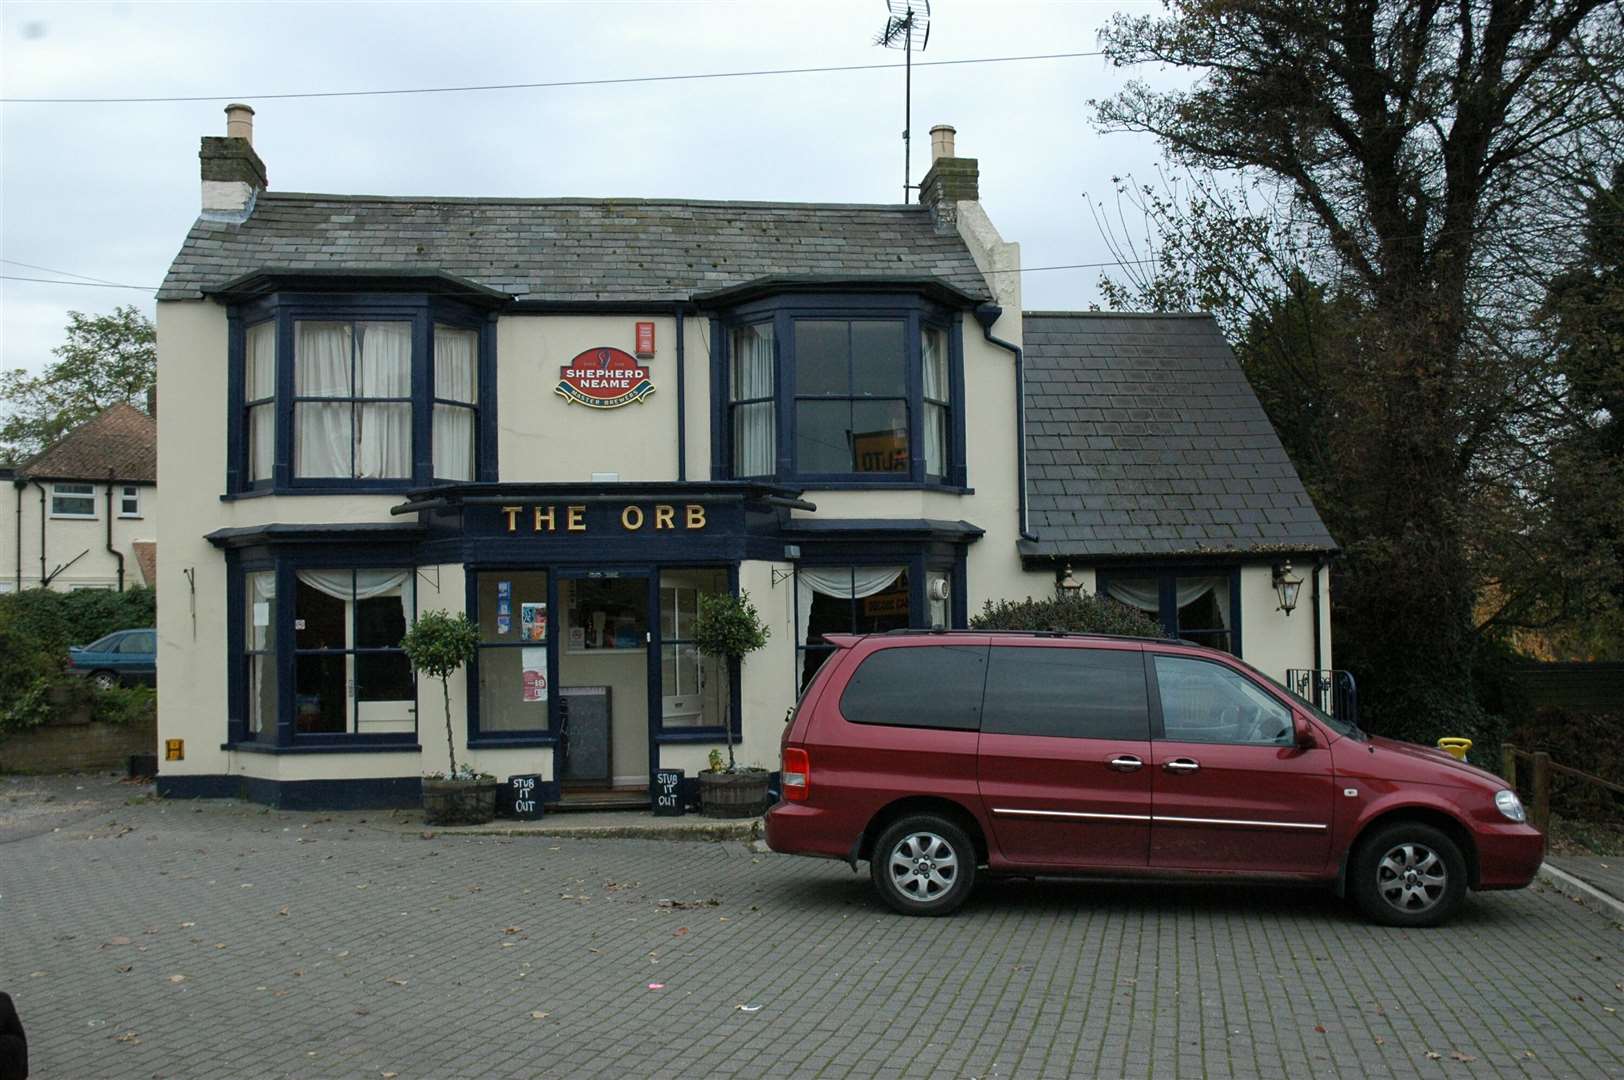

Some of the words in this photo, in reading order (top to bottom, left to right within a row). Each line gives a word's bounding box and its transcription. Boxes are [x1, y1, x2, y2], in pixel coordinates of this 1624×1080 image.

[566, 369, 644, 378] SHEPHERD
[580, 379, 630, 388] NEAME
[571, 389, 601, 405] MASTER
[604, 391, 639, 406] BREWERS
[502, 505, 587, 531] THE
[621, 504, 707, 530] ORB
[513, 778, 535, 789] STUB
[657, 773, 678, 785] STUB
[519, 787, 531, 799] IT
[664, 784, 674, 794] IT
[515, 799, 536, 813] OUT
[658, 794, 678, 807] OUT
